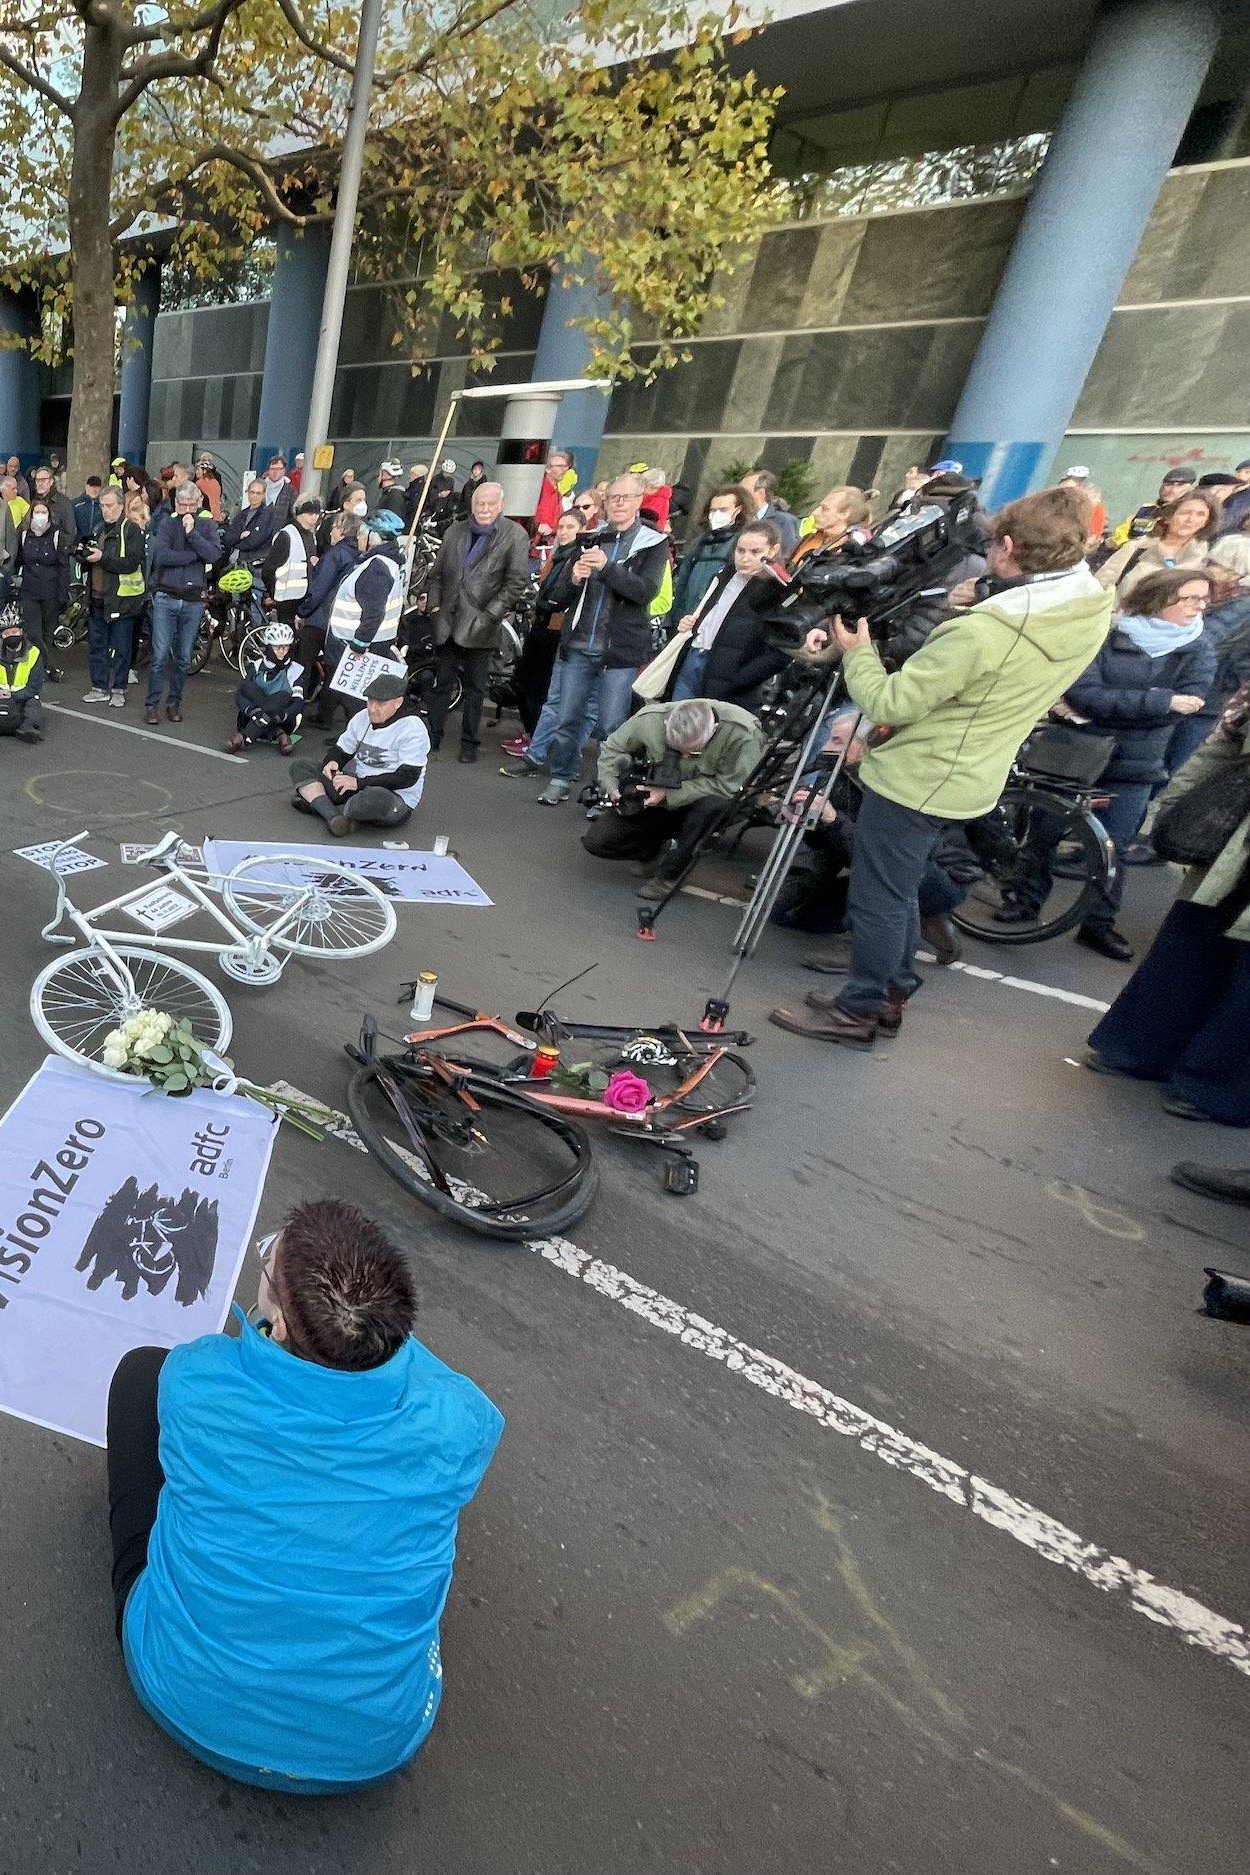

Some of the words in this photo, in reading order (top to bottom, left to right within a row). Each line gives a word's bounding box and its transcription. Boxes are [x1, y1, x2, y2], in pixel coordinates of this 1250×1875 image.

[350, 655, 369, 691] KILLING
[56, 859, 98, 872] STOP
[189, 1122, 230, 1176] adfc
